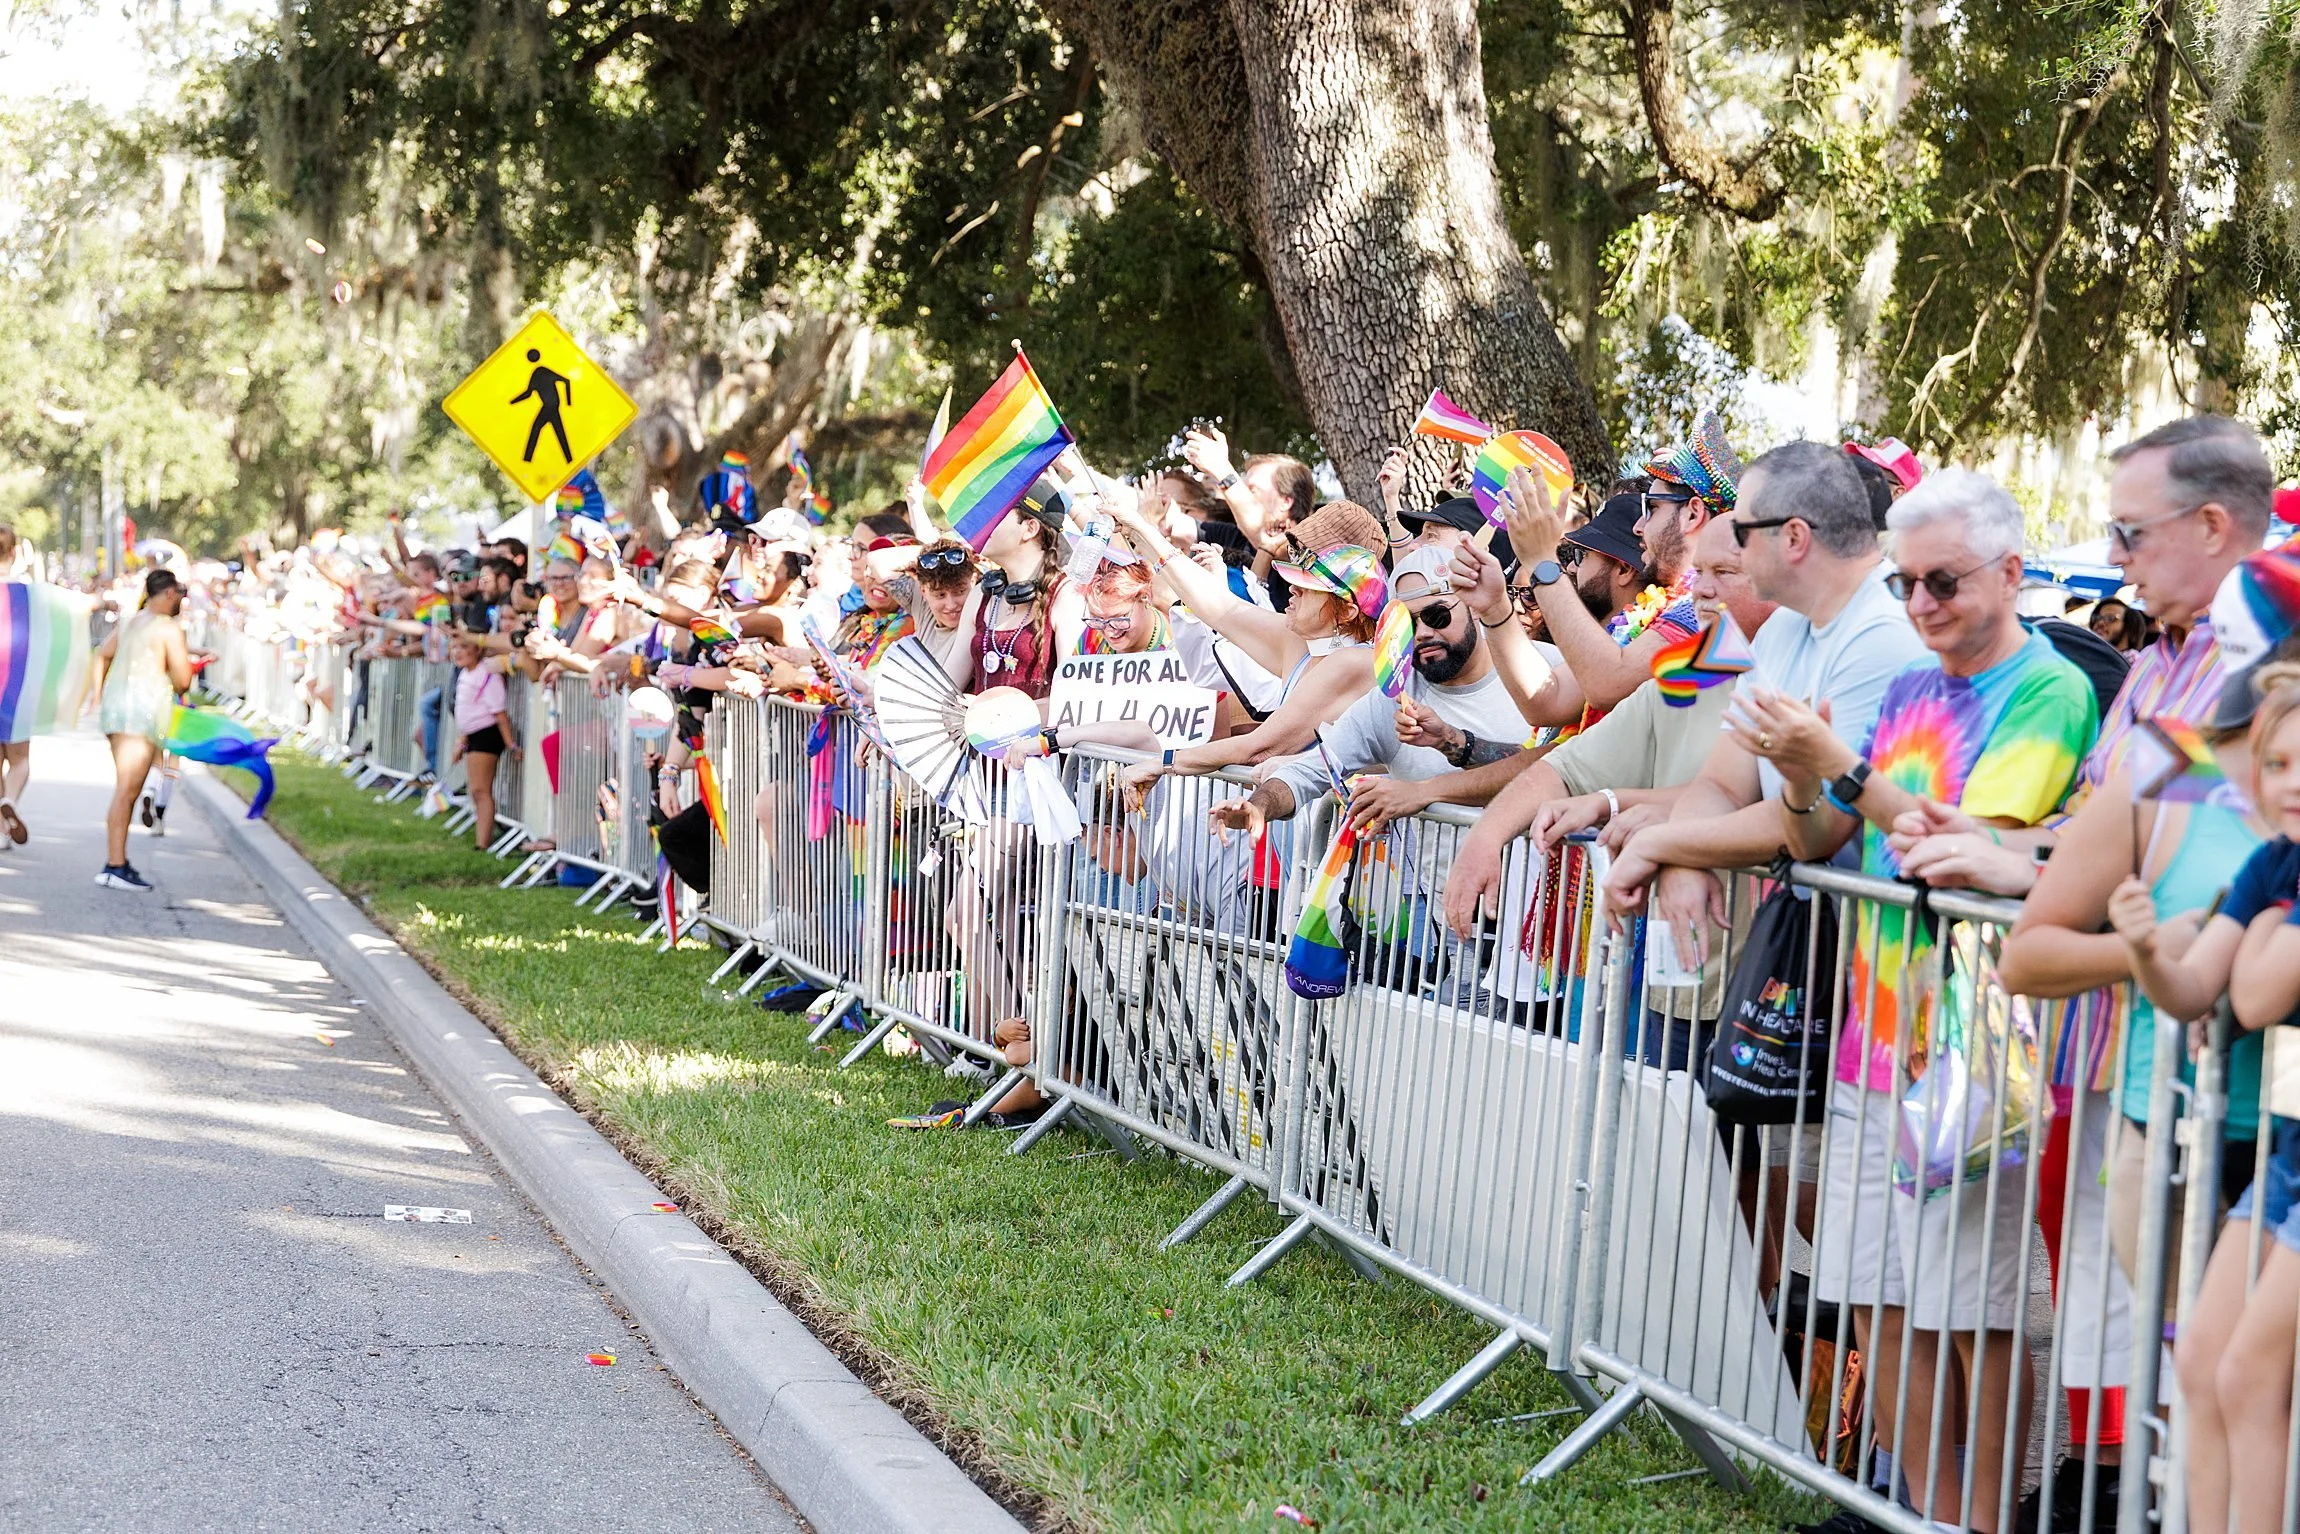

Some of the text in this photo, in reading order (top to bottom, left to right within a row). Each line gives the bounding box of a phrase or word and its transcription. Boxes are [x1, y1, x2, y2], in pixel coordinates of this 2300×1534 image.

[1062, 658, 1187, 685] ONE FOR AL
[1149, 704, 1209, 741] ONE
